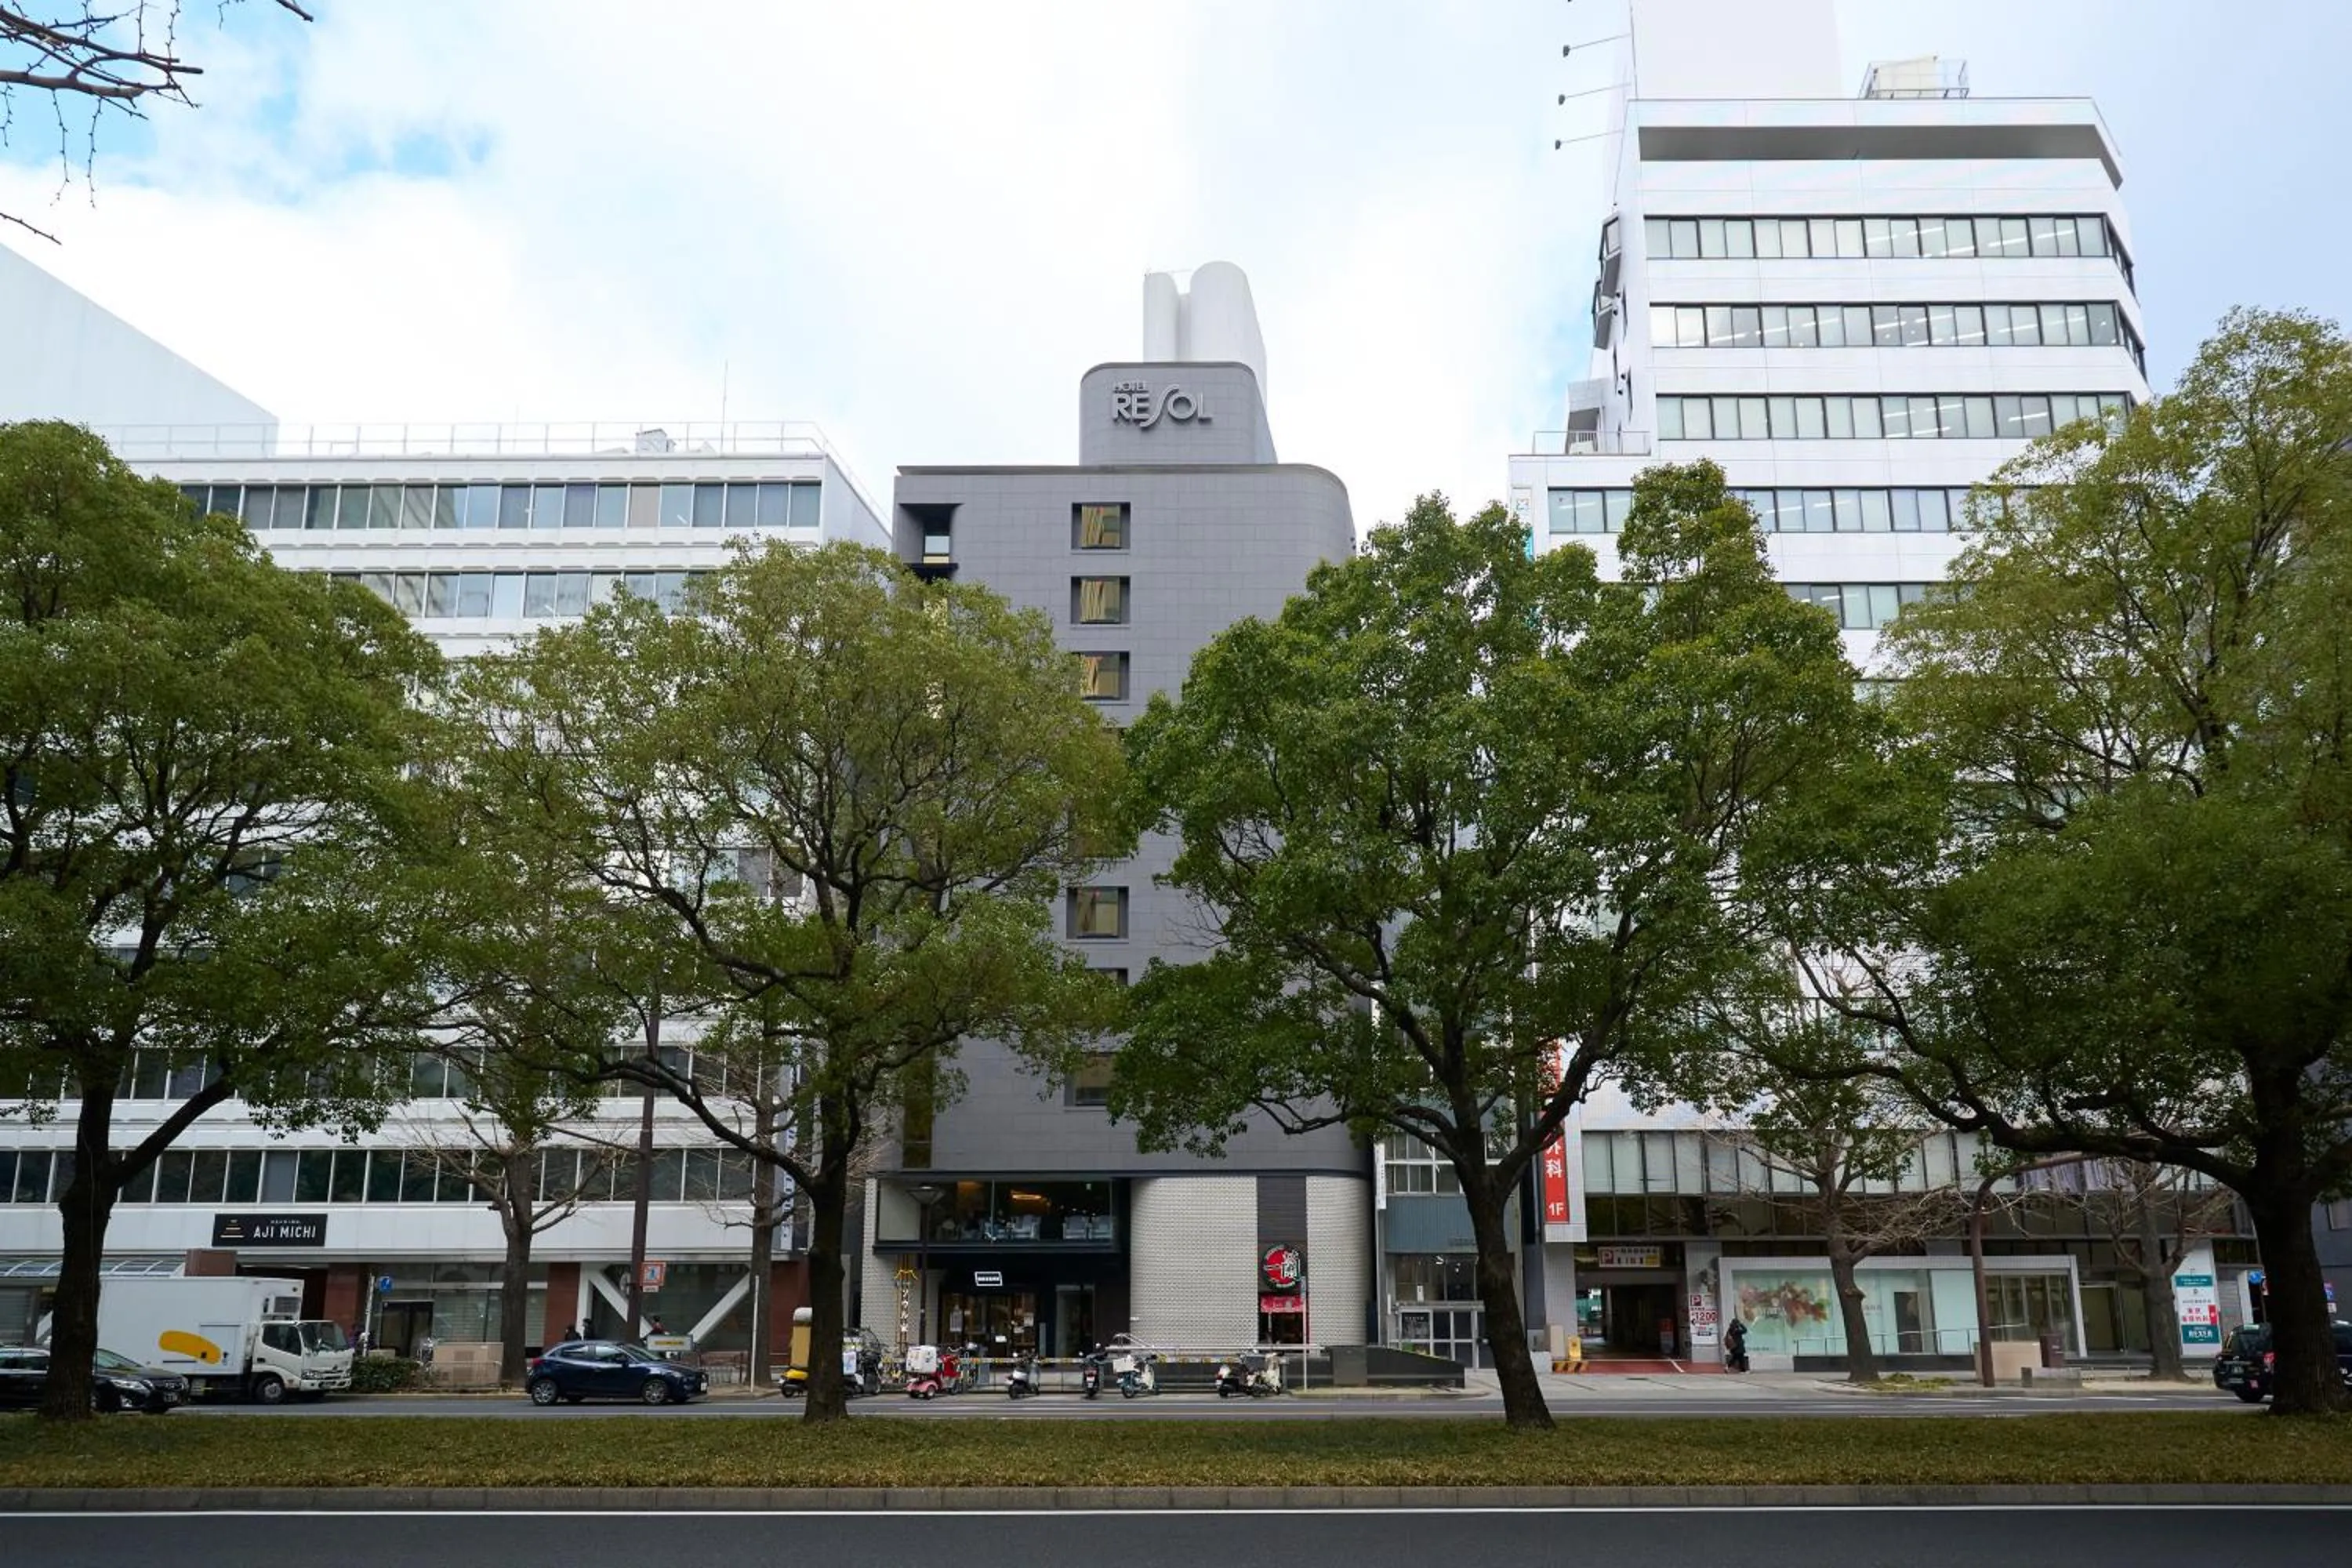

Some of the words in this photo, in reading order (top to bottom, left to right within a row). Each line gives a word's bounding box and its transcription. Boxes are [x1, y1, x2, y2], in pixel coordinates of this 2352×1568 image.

[1112, 384, 1212, 428] RESOL
[1548, 1202, 1564, 1216] 1F
[253, 1225, 274, 1239] AJI
[279, 1225, 316, 1239] MICHI
